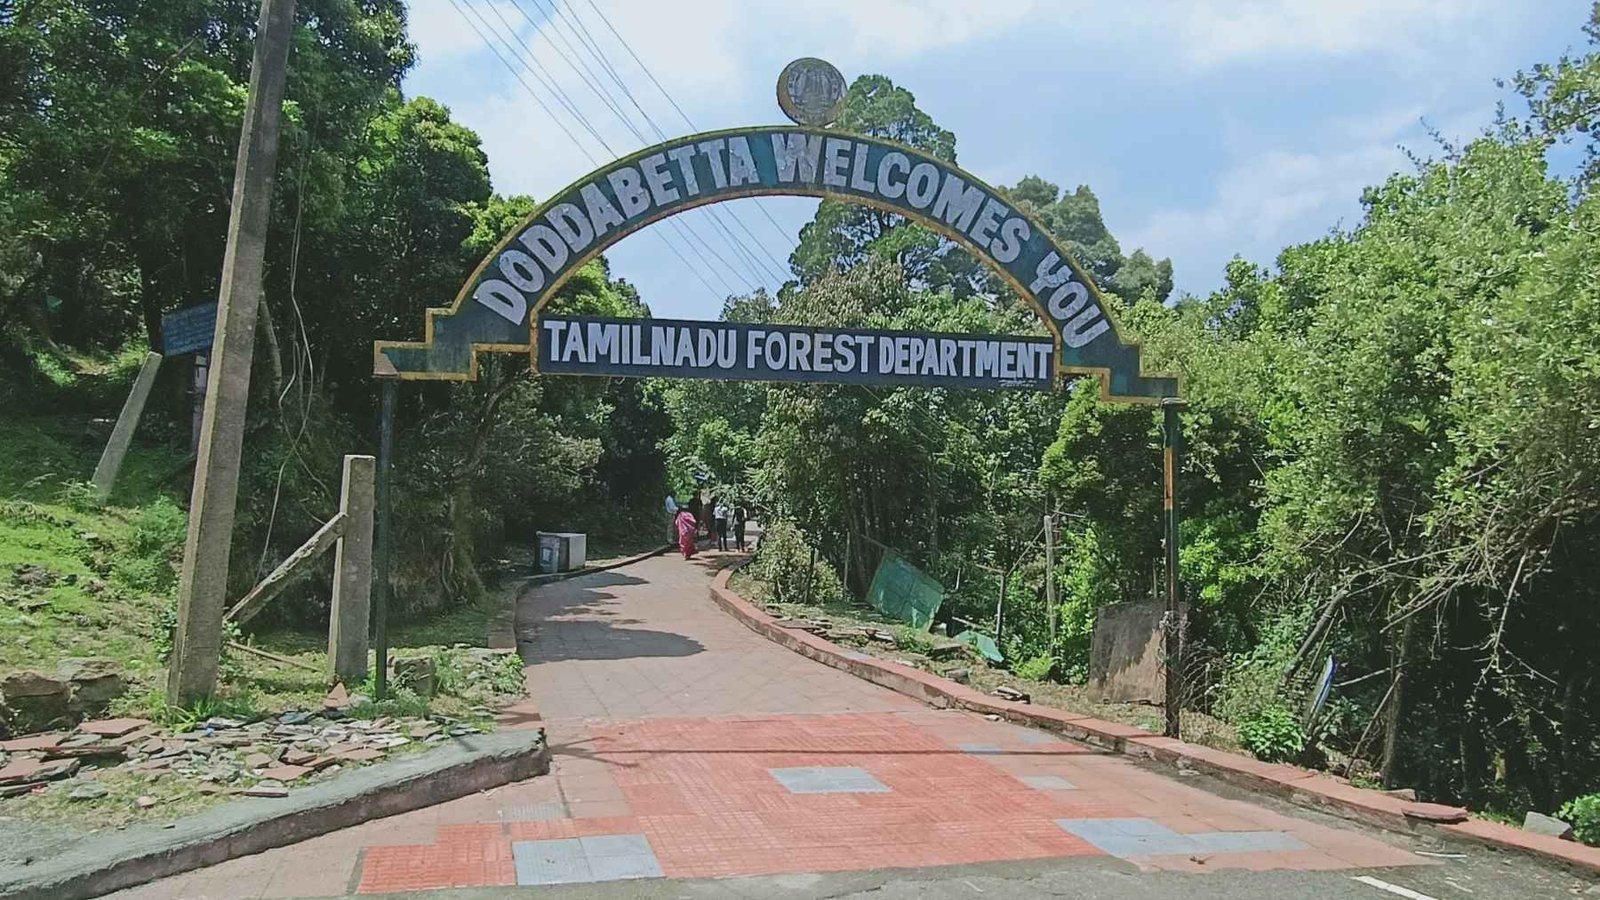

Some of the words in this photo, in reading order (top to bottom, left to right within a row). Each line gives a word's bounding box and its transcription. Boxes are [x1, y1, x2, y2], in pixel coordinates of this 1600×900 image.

[473, 136, 760, 326] DODDABETTA
[771, 133, 1031, 264] WELCOMES
[1031, 252, 1109, 348] YOU
[543, 320, 737, 368] TAMILNADU
[747, 331, 874, 373] FOREST
[880, 337, 1052, 379] DEPARTMENT
